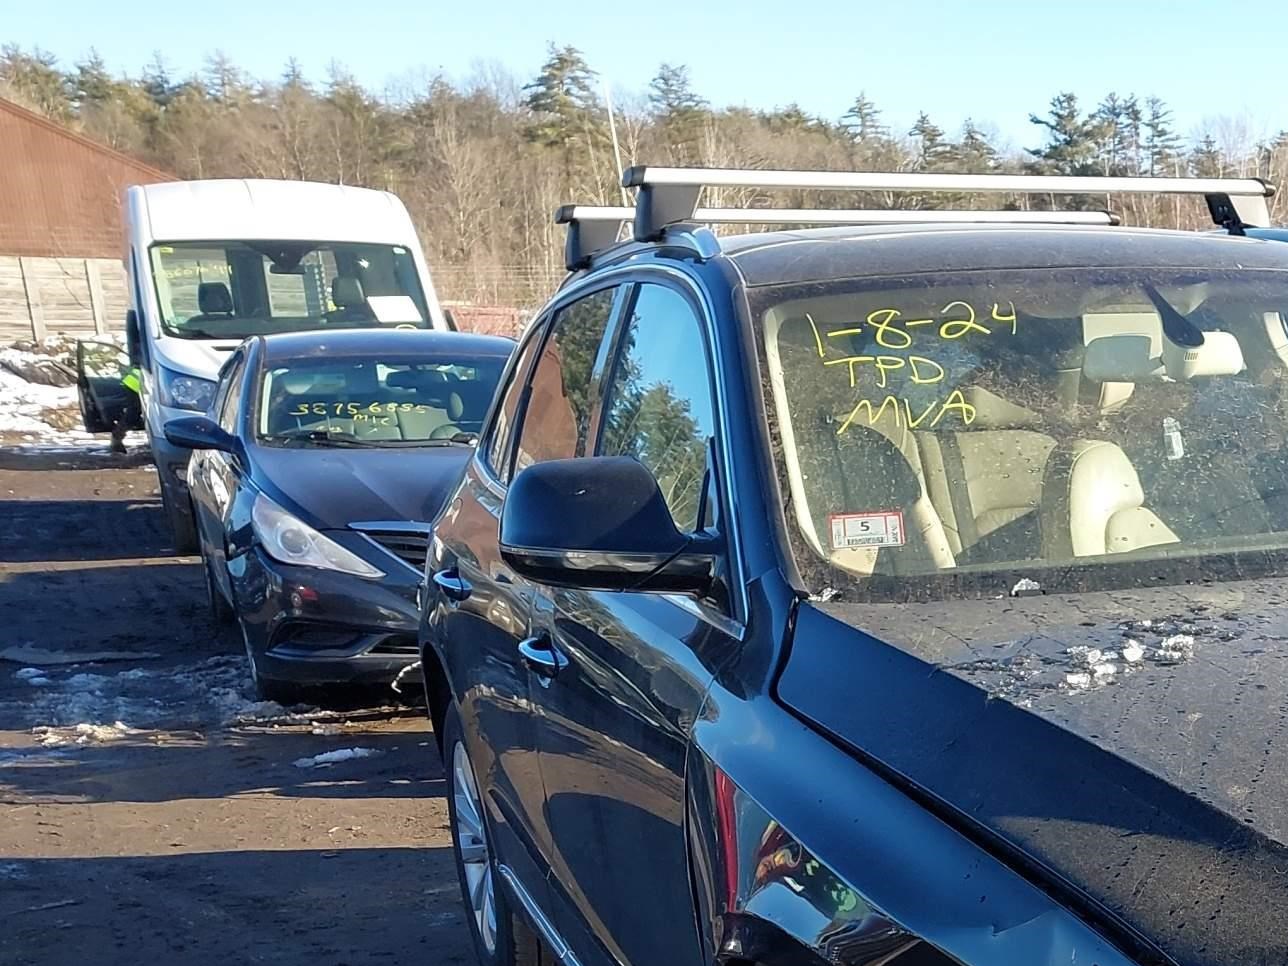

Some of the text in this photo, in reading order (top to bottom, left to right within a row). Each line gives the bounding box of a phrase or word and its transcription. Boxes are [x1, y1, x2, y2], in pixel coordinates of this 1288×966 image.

[806, 300, 1017, 357] 1-8-24
[824, 355, 944, 388] TPD
[836, 390, 977, 435] MVA
[860, 521, 871, 532] 5
